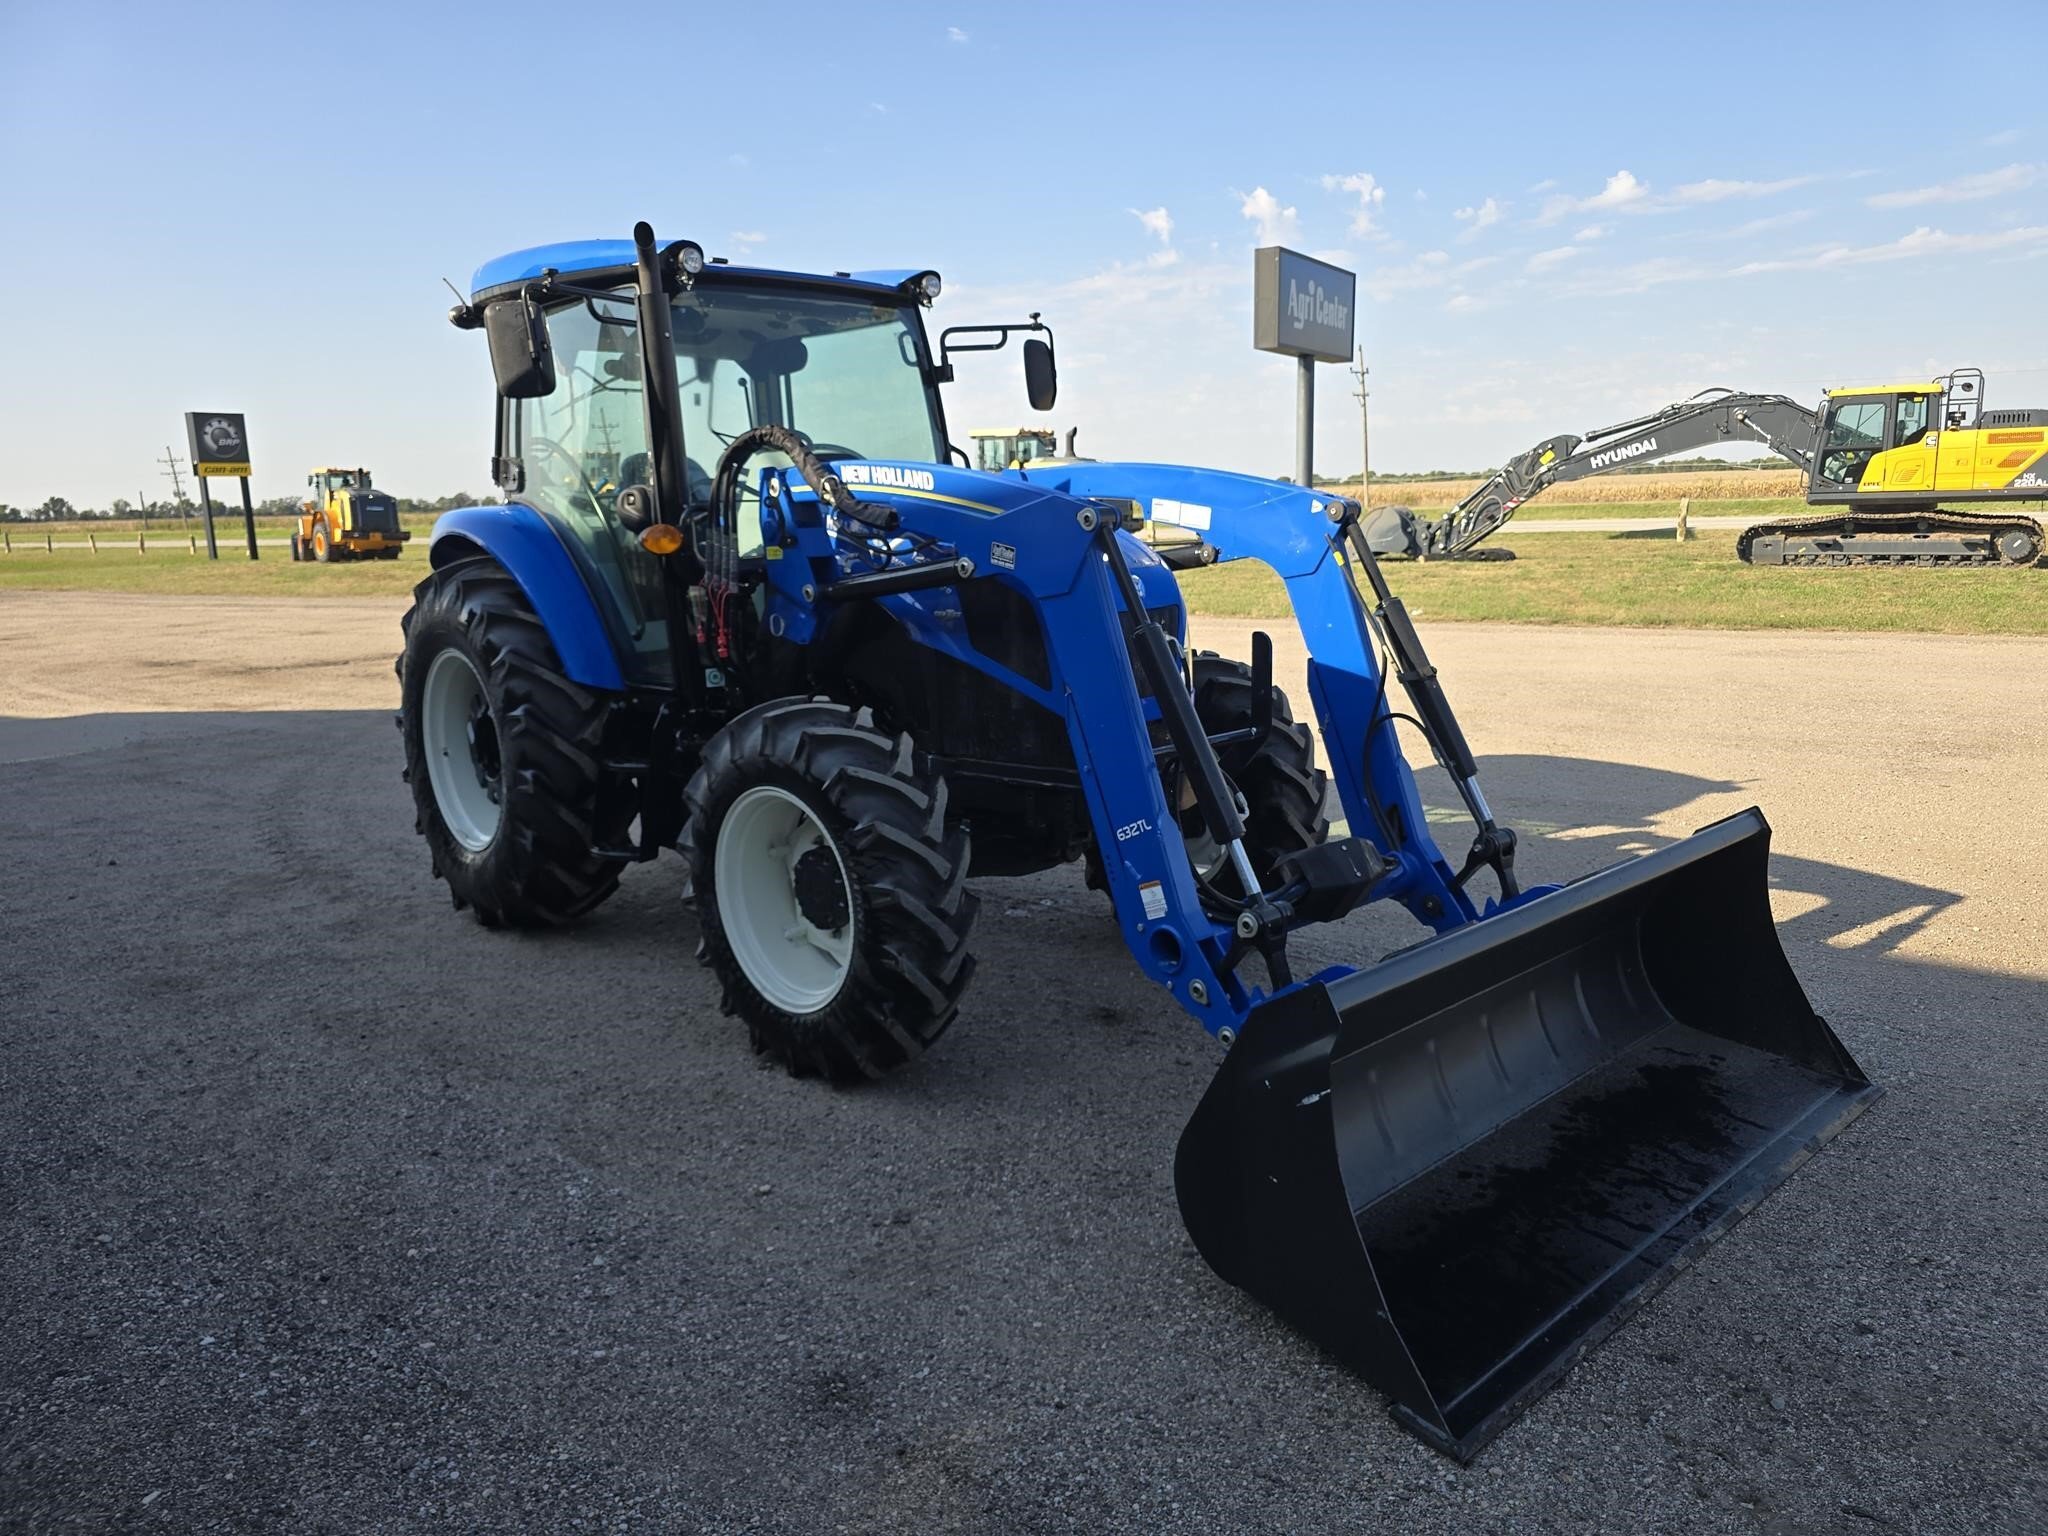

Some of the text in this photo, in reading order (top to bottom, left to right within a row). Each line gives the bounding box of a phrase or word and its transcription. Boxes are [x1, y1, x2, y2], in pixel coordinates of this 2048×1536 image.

[1288, 278, 1348, 330] Agri Center
[218, 438, 240, 447] BRP
[1590, 437, 1657, 469] HYUNDAI
[840, 465, 935, 491] NEW HOLLAND
[1116, 818, 1153, 841] 632TL
